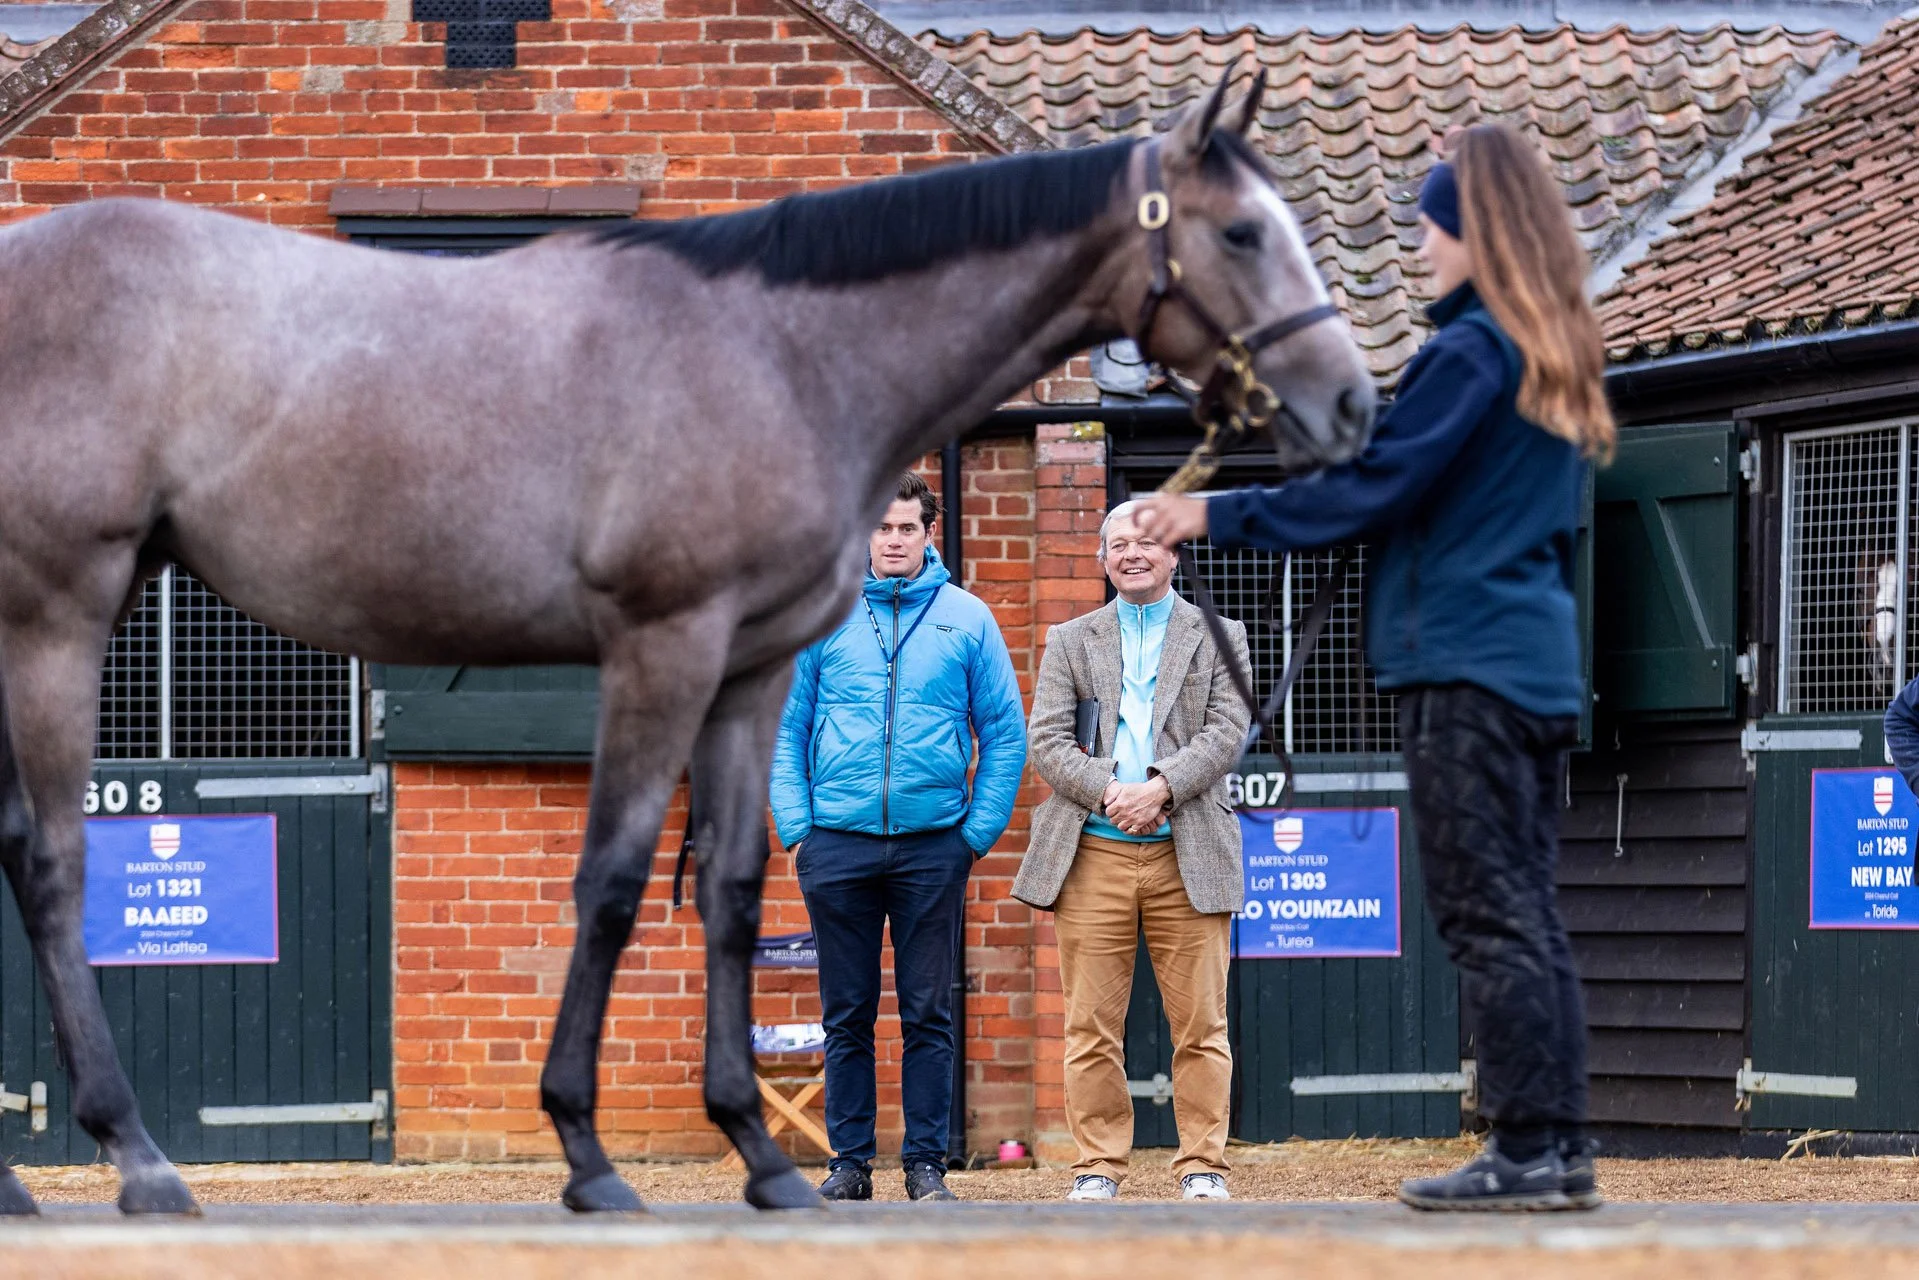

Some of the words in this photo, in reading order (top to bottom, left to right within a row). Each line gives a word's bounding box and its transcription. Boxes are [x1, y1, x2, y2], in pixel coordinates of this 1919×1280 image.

[82, 780, 163, 814] 608
[1226, 772, 1286, 806] 607
[1857, 818, 1888, 830] BARTON
[1889, 818, 1908, 830] STUD
[1857, 840, 1873, 856] Lot
[1876, 837, 1907, 856] 1295
[126, 862, 173, 873] BARTON
[176, 861, 206, 872] STUD
[1249, 855, 1296, 867] BARTON
[1298, 855, 1328, 866] STUD
[1251, 875, 1275, 891] Lot
[1280, 872, 1327, 891] 1303
[1851, 866, 1882, 887] NEW
[1886, 866, 1913, 887] BAY
[127, 882, 152, 898] Lot
[156, 879, 202, 897] 1321
[124, 906, 208, 927] BAAEED
[1267, 898, 1381, 919] YOUMZAIN
[163, 941, 208, 955] Lattea
[1277, 934, 1314, 949] Turea
